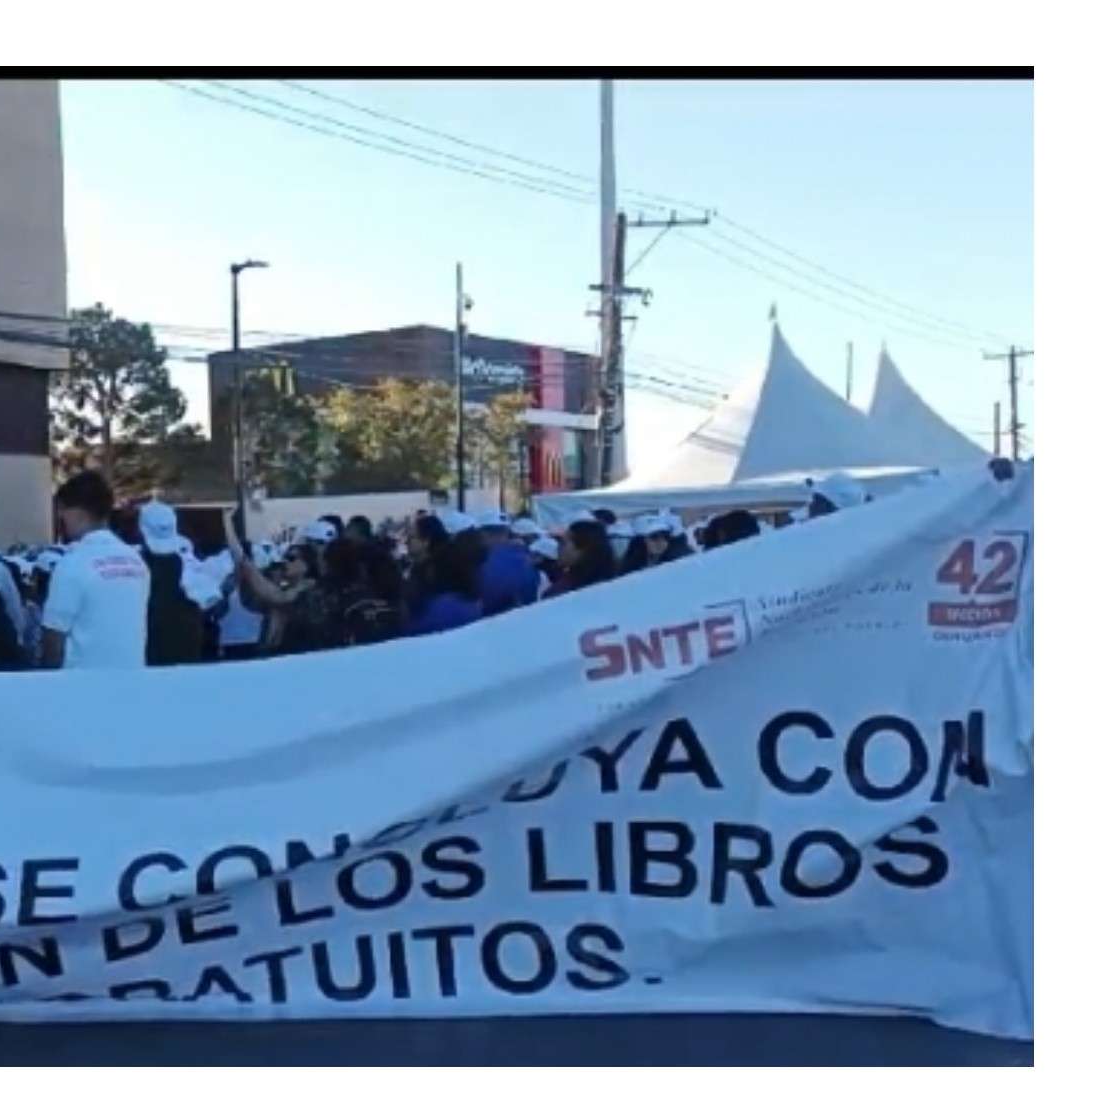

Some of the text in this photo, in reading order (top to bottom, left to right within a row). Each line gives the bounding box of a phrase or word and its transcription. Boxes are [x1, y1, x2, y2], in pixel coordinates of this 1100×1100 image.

[936, 539, 1017, 595] 42
[579, 616, 737, 681] SNTE
[758, 711, 990, 802] CON
[103, 905, 239, 962] DE
[276, 835, 485, 926] LOS
[527, 815, 949, 908] LIBROS
